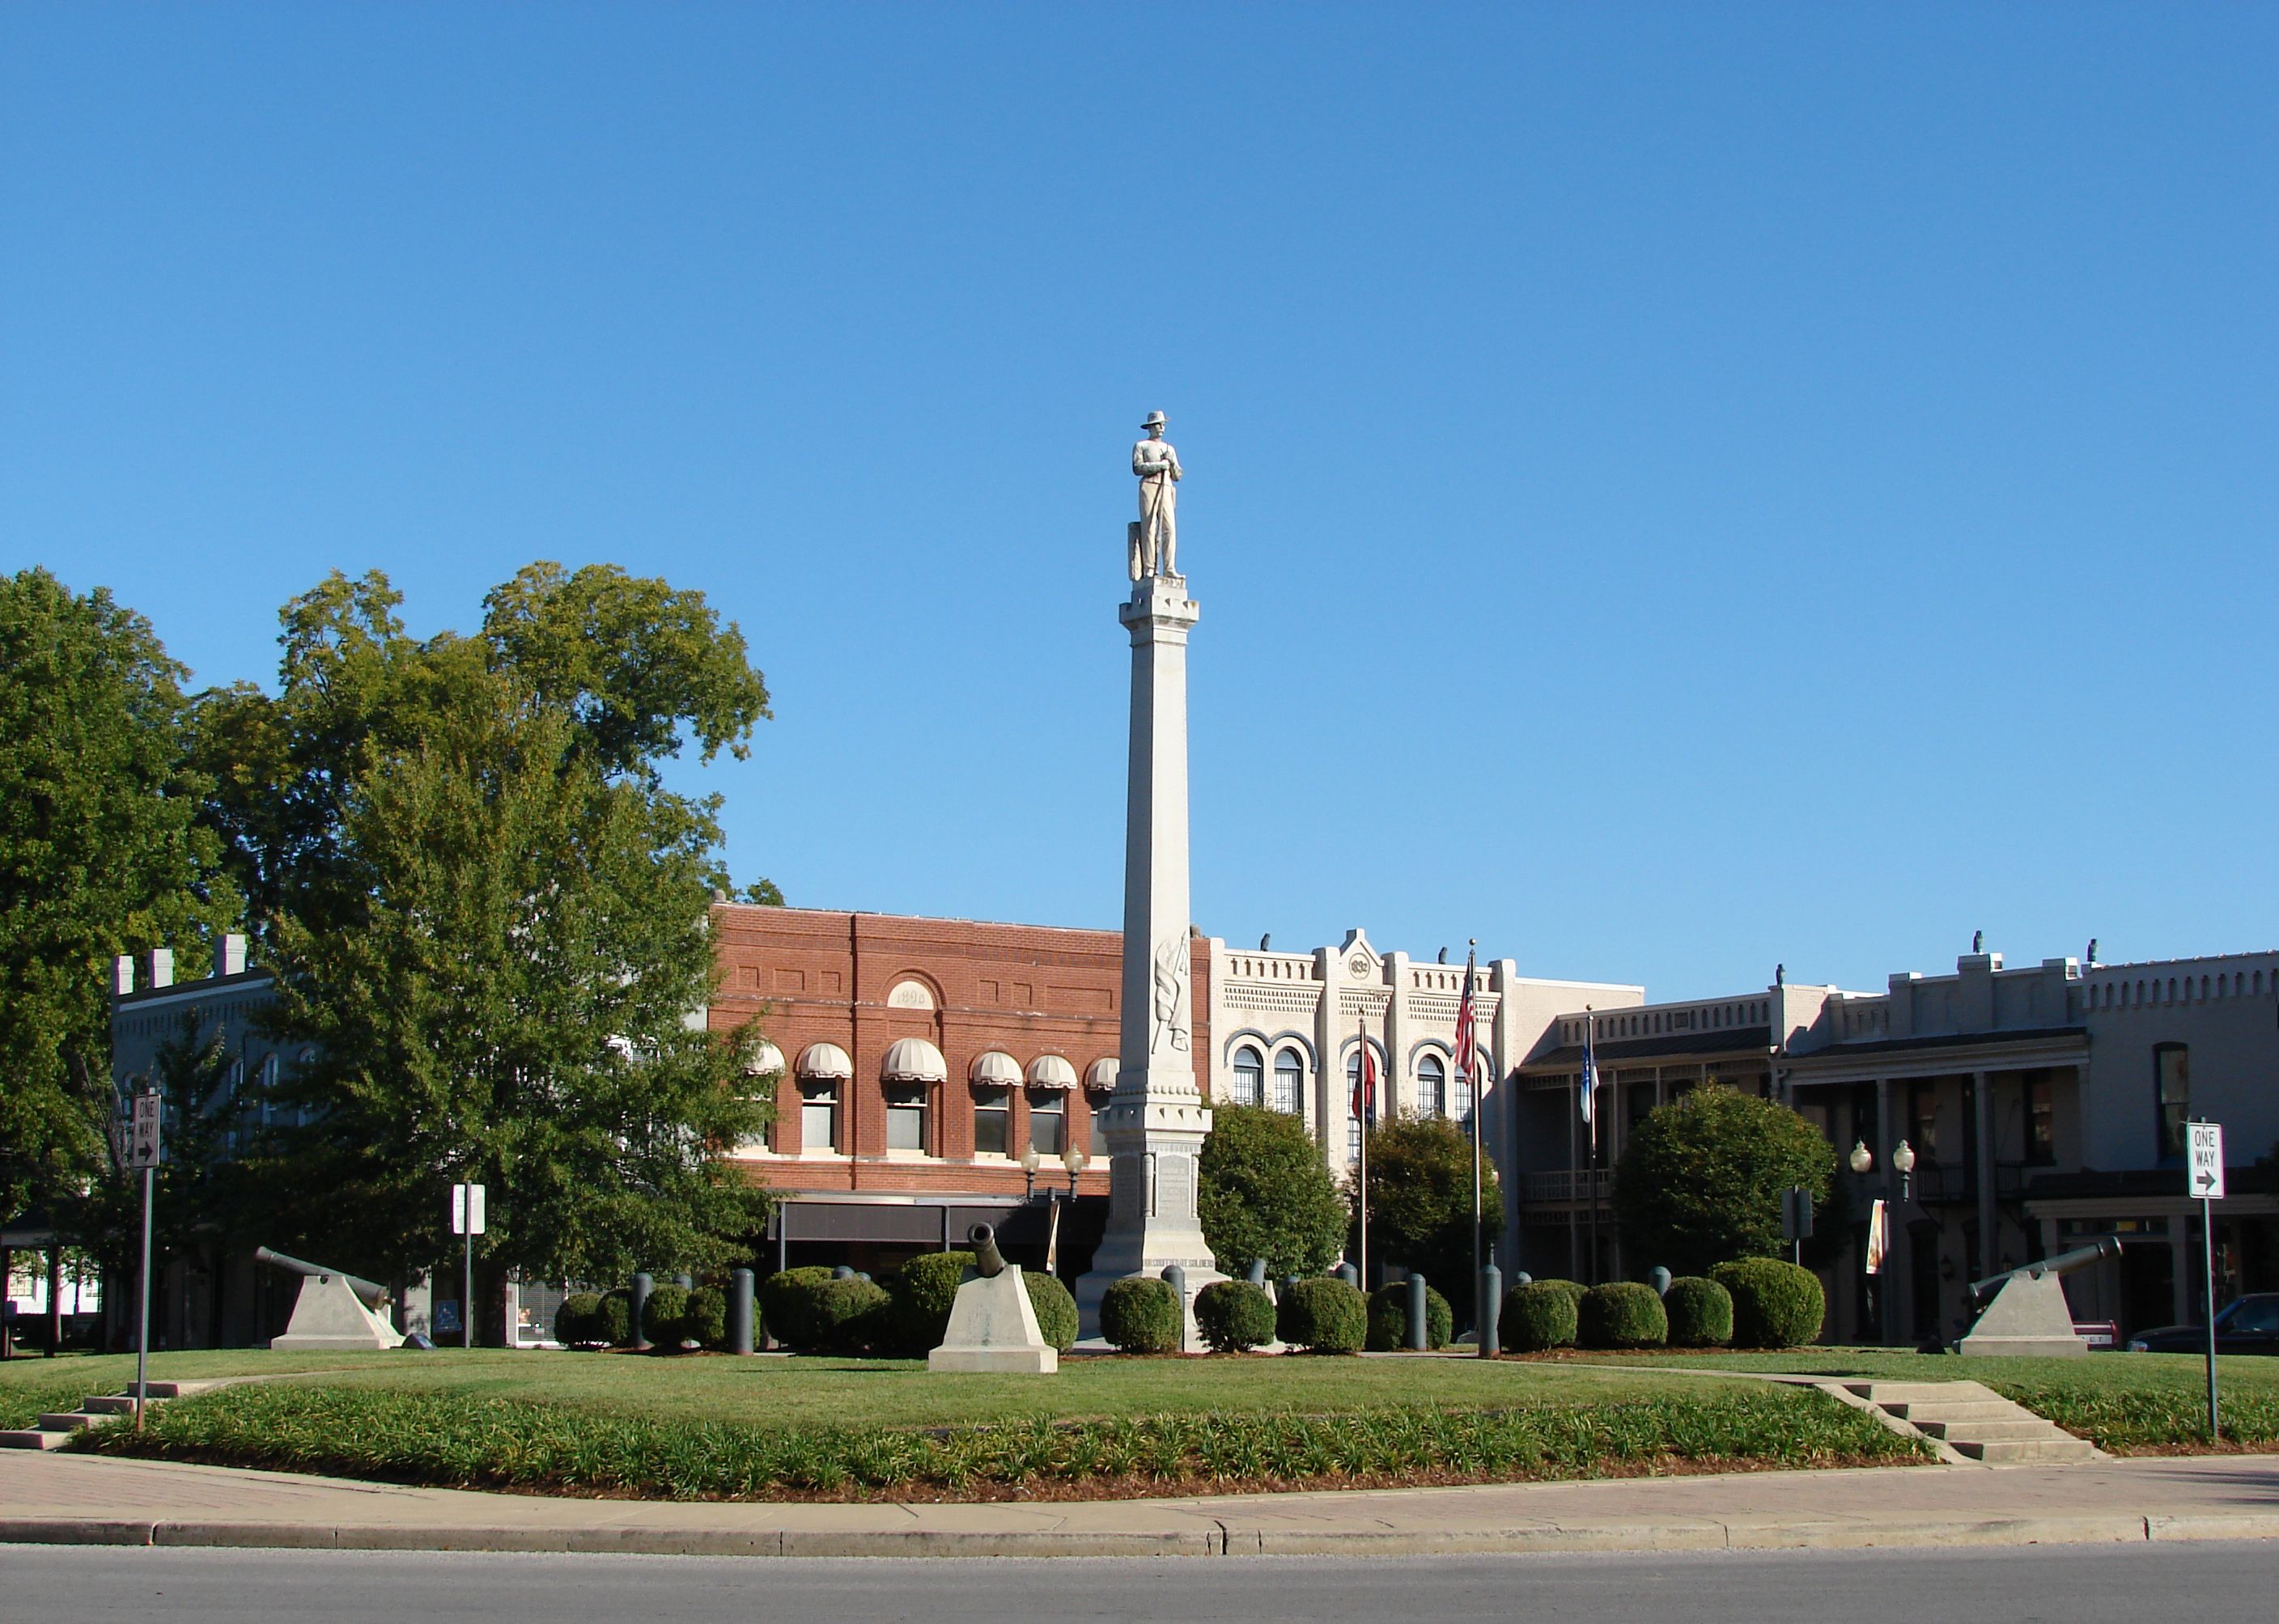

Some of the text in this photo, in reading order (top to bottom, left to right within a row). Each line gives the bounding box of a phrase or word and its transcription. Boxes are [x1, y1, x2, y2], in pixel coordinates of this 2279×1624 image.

[1351, 960, 1368, 974] 1892
[896, 990, 925, 1004] 1890
[139, 1101, 155, 1118] ONE
[138, 1122, 154, 1138] WAY
[2194, 1130, 2215, 1147] ONE
[2195, 1151, 2215, 1167] WAY
